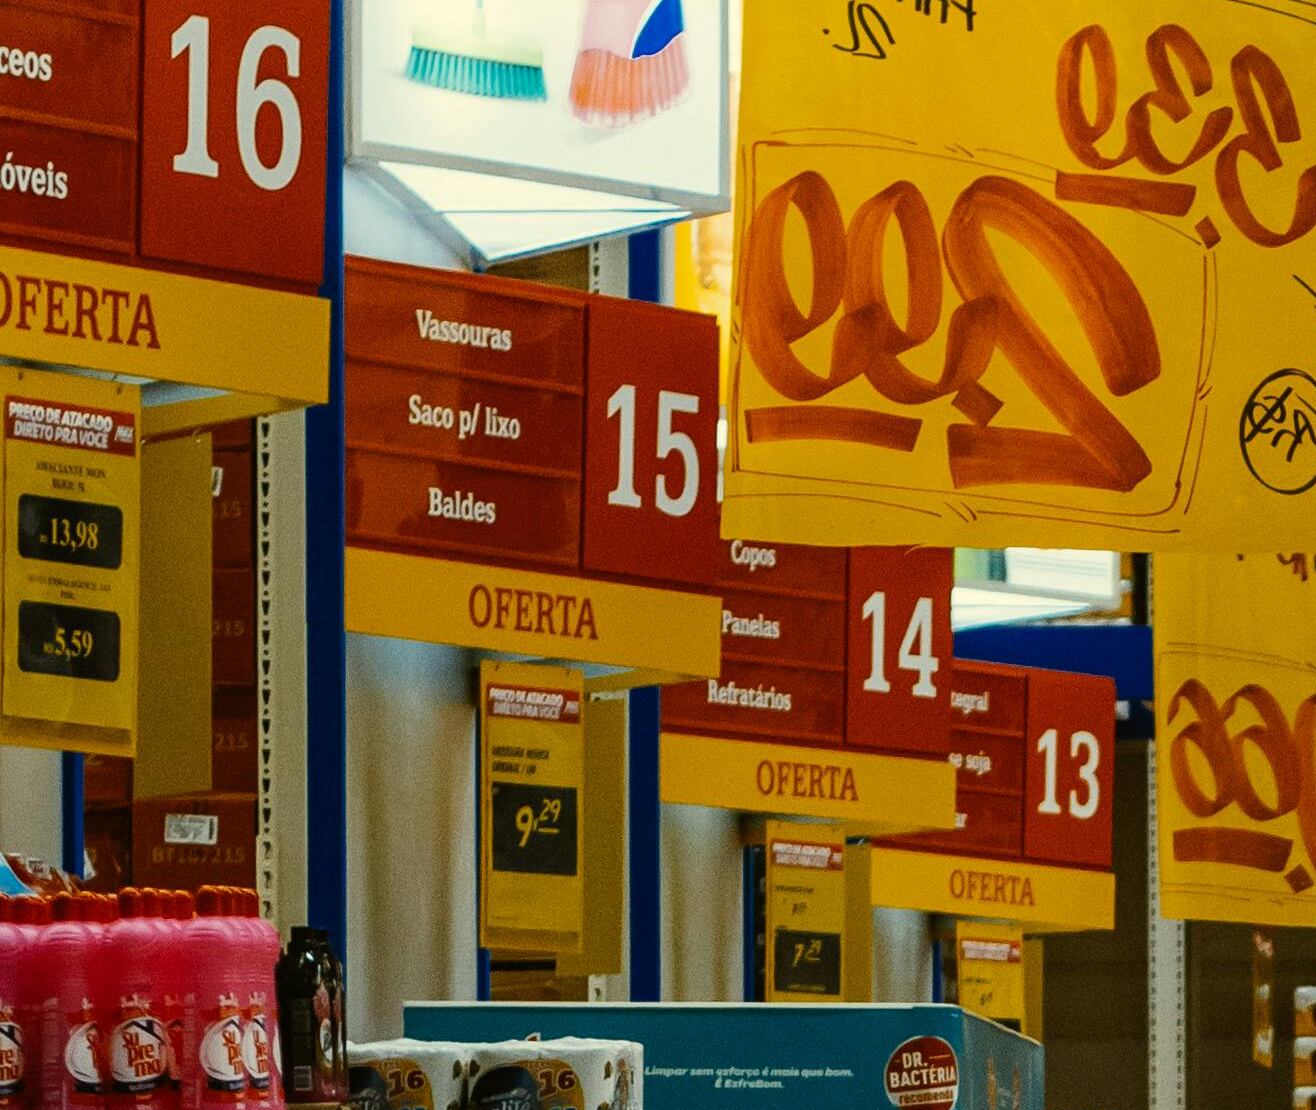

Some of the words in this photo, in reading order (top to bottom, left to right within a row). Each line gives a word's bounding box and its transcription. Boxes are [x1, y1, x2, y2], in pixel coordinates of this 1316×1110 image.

[0, 46, 53, 82] ceos
[171, 14, 303, 191] 16
[0, 152, 68, 200] óveis
[416, 309, 512, 351] Vassouras
[14, 419, 54, 441] DIRETO
[54, 426, 79, 445] PRA
[61, 410, 114, 434] ATACADO
[408, 394, 454, 430] Saco
[459, 402, 480, 440] p/
[484, 405, 522, 440] lixo
[606, 383, 701, 518] 15
[428, 486, 496, 525] Baldes
[50, 517, 99, 553] 13,98
[731, 540, 777, 571] Copos
[467, 583, 600, 641] OFERTA
[721, 609, 780, 640] Panelas
[54, 628, 94, 660] 5,59
[861, 591, 939, 699] 14
[707, 678, 792, 711] Refratários
[756, 759, 860, 801] OFERTA
[965, 750, 993, 777] soja
[1037, 728, 1101, 820] 13
[515, 799, 562, 849] 9,29
[949, 867, 1036, 906] OFERTA
[644, 1065, 689, 1078] Limpar
[770, 1066, 800, 1077] mais
[889, 1065, 957, 1089] BACTÉRIA
[902, 1051, 929, 1069] DR.
[537, 1067, 576, 1097] 16
